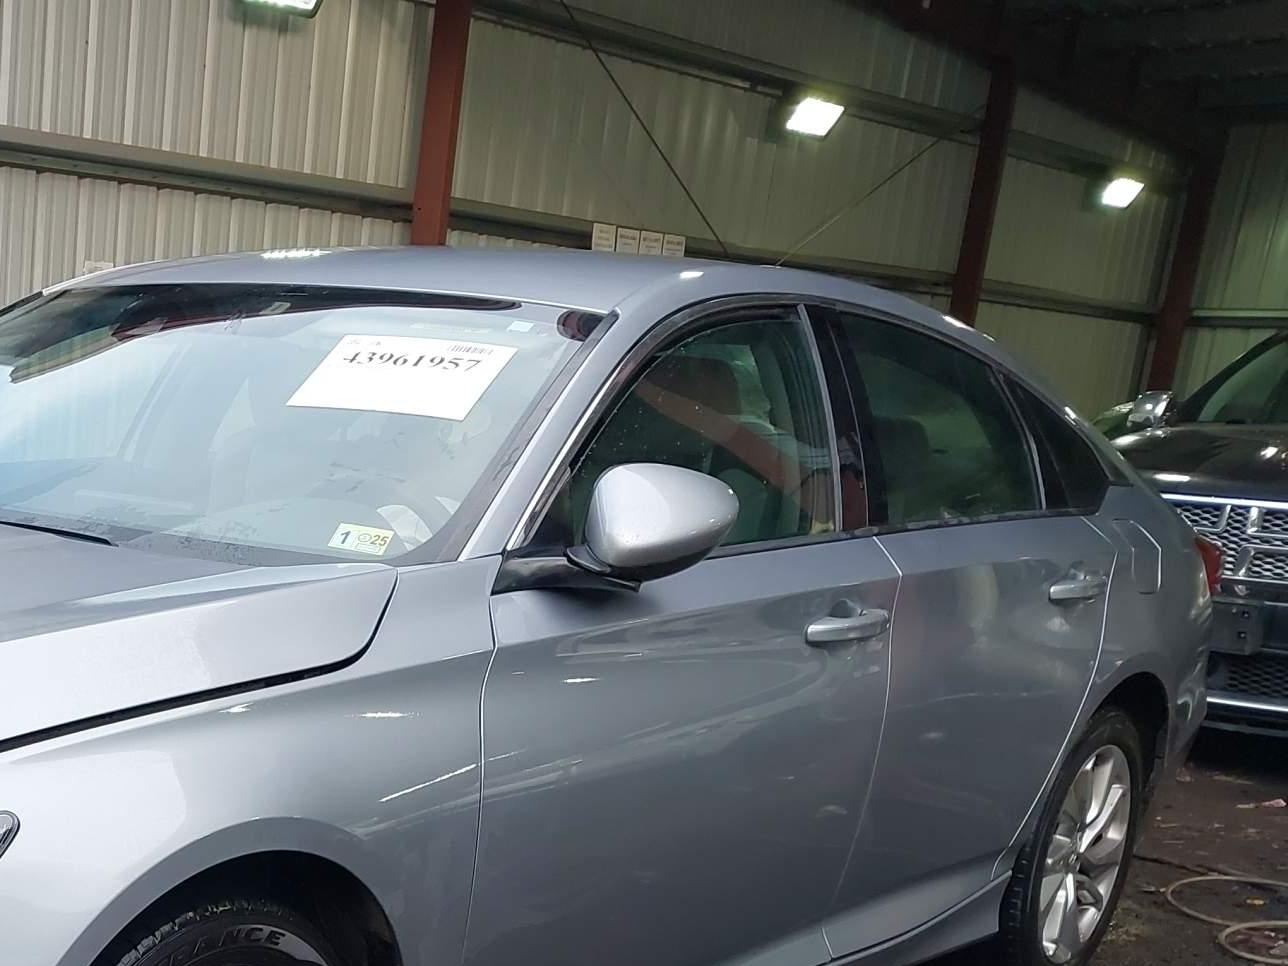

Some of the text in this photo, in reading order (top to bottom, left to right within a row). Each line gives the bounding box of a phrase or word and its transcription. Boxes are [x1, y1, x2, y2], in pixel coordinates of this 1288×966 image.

[343, 351, 482, 371] 43961957
[340, 530, 351, 544] 1
[370, 534, 388, 546] 25
